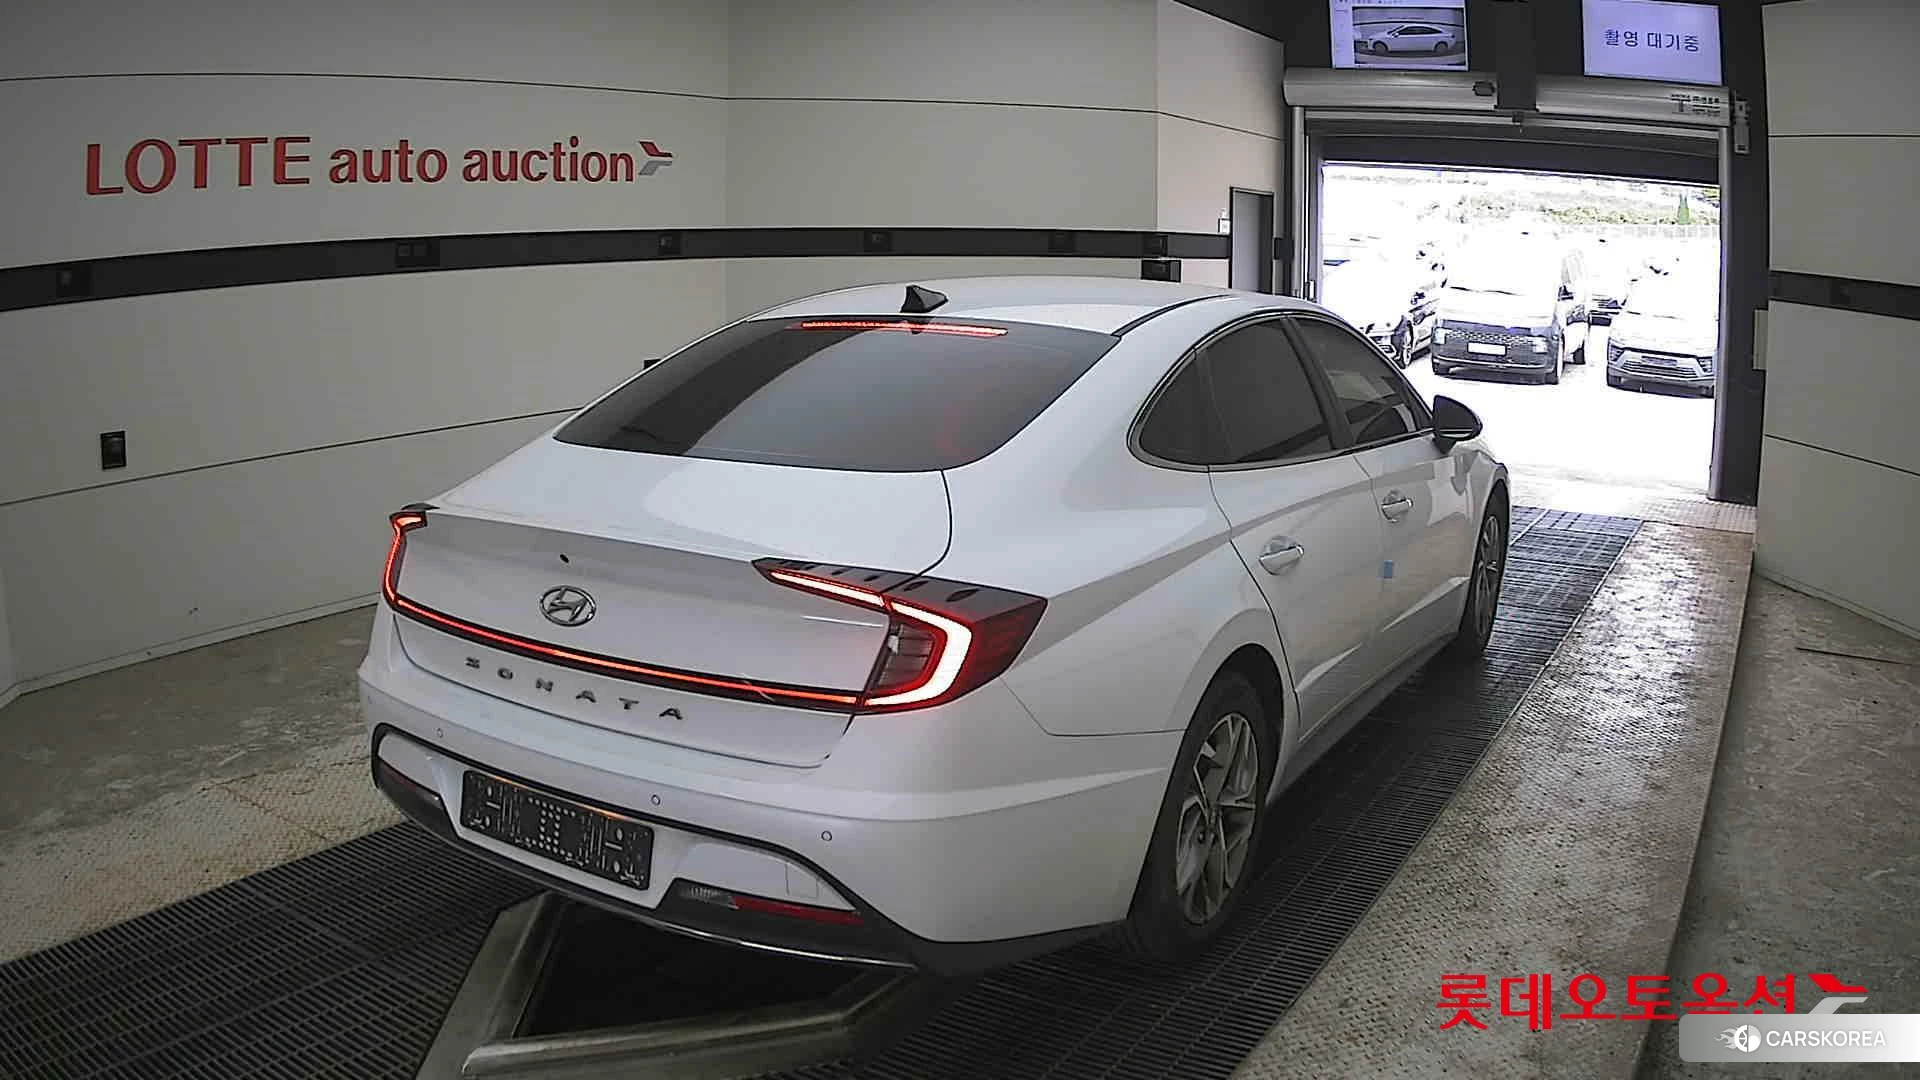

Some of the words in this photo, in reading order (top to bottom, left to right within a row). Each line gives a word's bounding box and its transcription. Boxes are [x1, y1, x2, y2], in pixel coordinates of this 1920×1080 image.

[1604, 28, 1639, 48] 촬영
[1646, 31, 1700, 53] 대기중
[85, 136, 311, 196] LOTTE
[328, 139, 449, 184] auto
[462, 136, 635, 183] auction
[465, 656, 684, 721] SONATA
